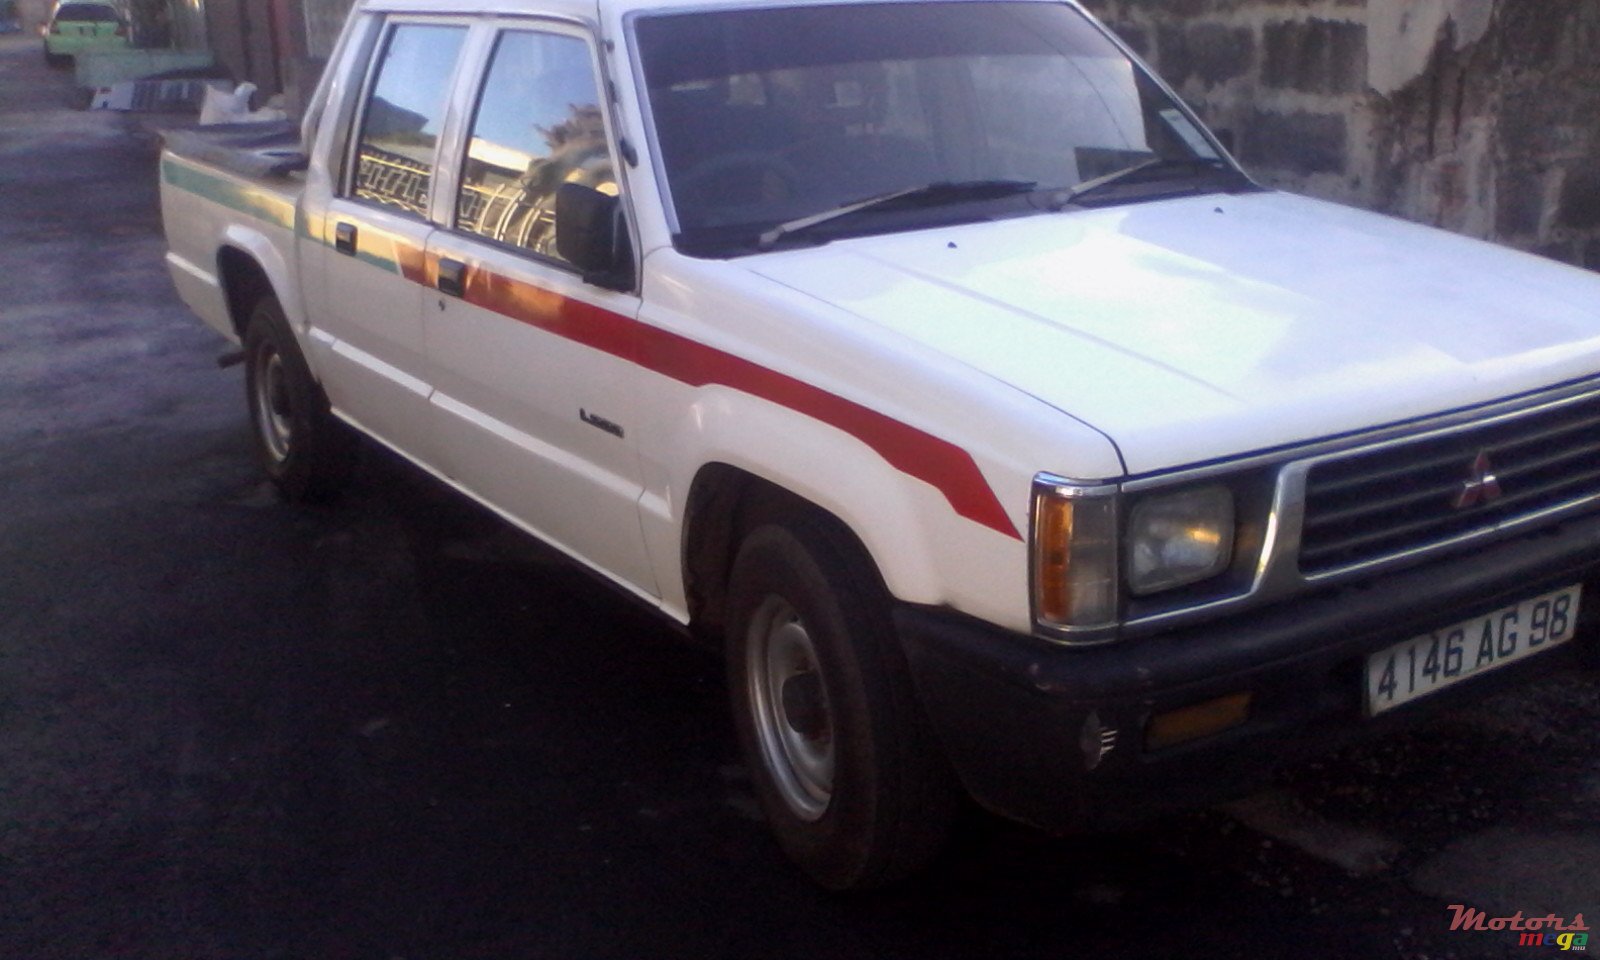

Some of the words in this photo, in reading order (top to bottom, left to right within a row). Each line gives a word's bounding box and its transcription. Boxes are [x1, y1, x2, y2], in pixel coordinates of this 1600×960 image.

[1378, 629, 1464, 700] 4146
[1475, 612, 1519, 667] AG
[1529, 594, 1571, 646] 98
